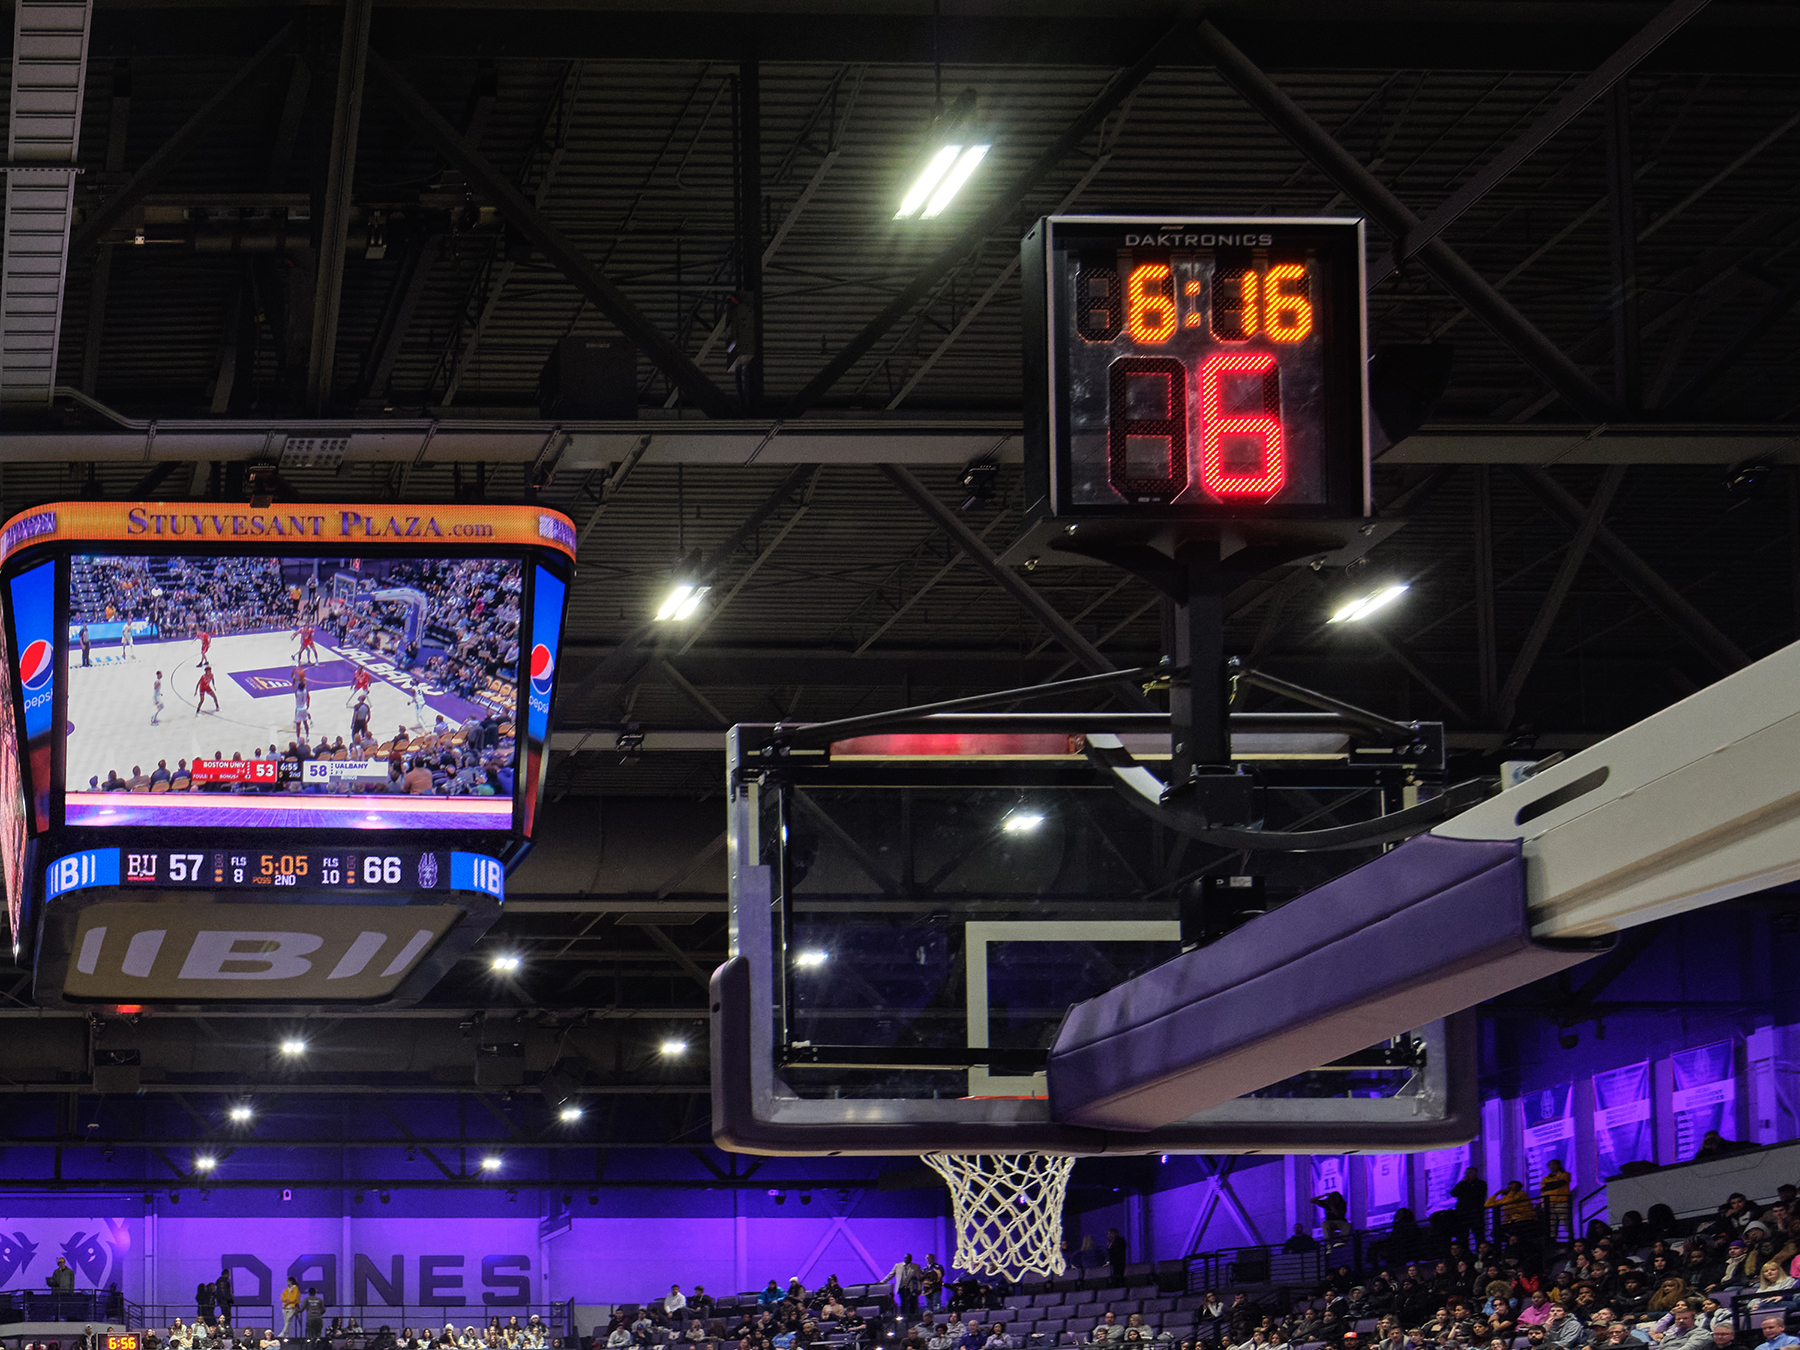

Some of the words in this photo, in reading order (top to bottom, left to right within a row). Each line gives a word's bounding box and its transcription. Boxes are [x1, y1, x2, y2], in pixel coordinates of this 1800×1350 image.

[1125, 233, 1273, 247] DAKTRONICS
[1129, 264, 1313, 343] 6:16
[1202, 355, 1284, 494] 6
[127, 508, 325, 536] STUYVESANT
[24, 688, 53, 713] pepsi
[528, 695, 549, 714] pepsi
[256, 764, 274, 777] 53
[309, 765, 328, 777] 58
[170, 854, 204, 881] 57
[231, 856, 247, 866] FLS
[261, 855, 308, 875] 5:05
[323, 858, 338, 867] FLS
[234, 869, 243, 882] 8
[321, 870, 340, 884] 10
[363, 857, 402, 884] 66
[274, 875, 296, 886] 2ND
[221, 1254, 531, 1307] DANES
[108, 1337, 136, 1350] 6:56
